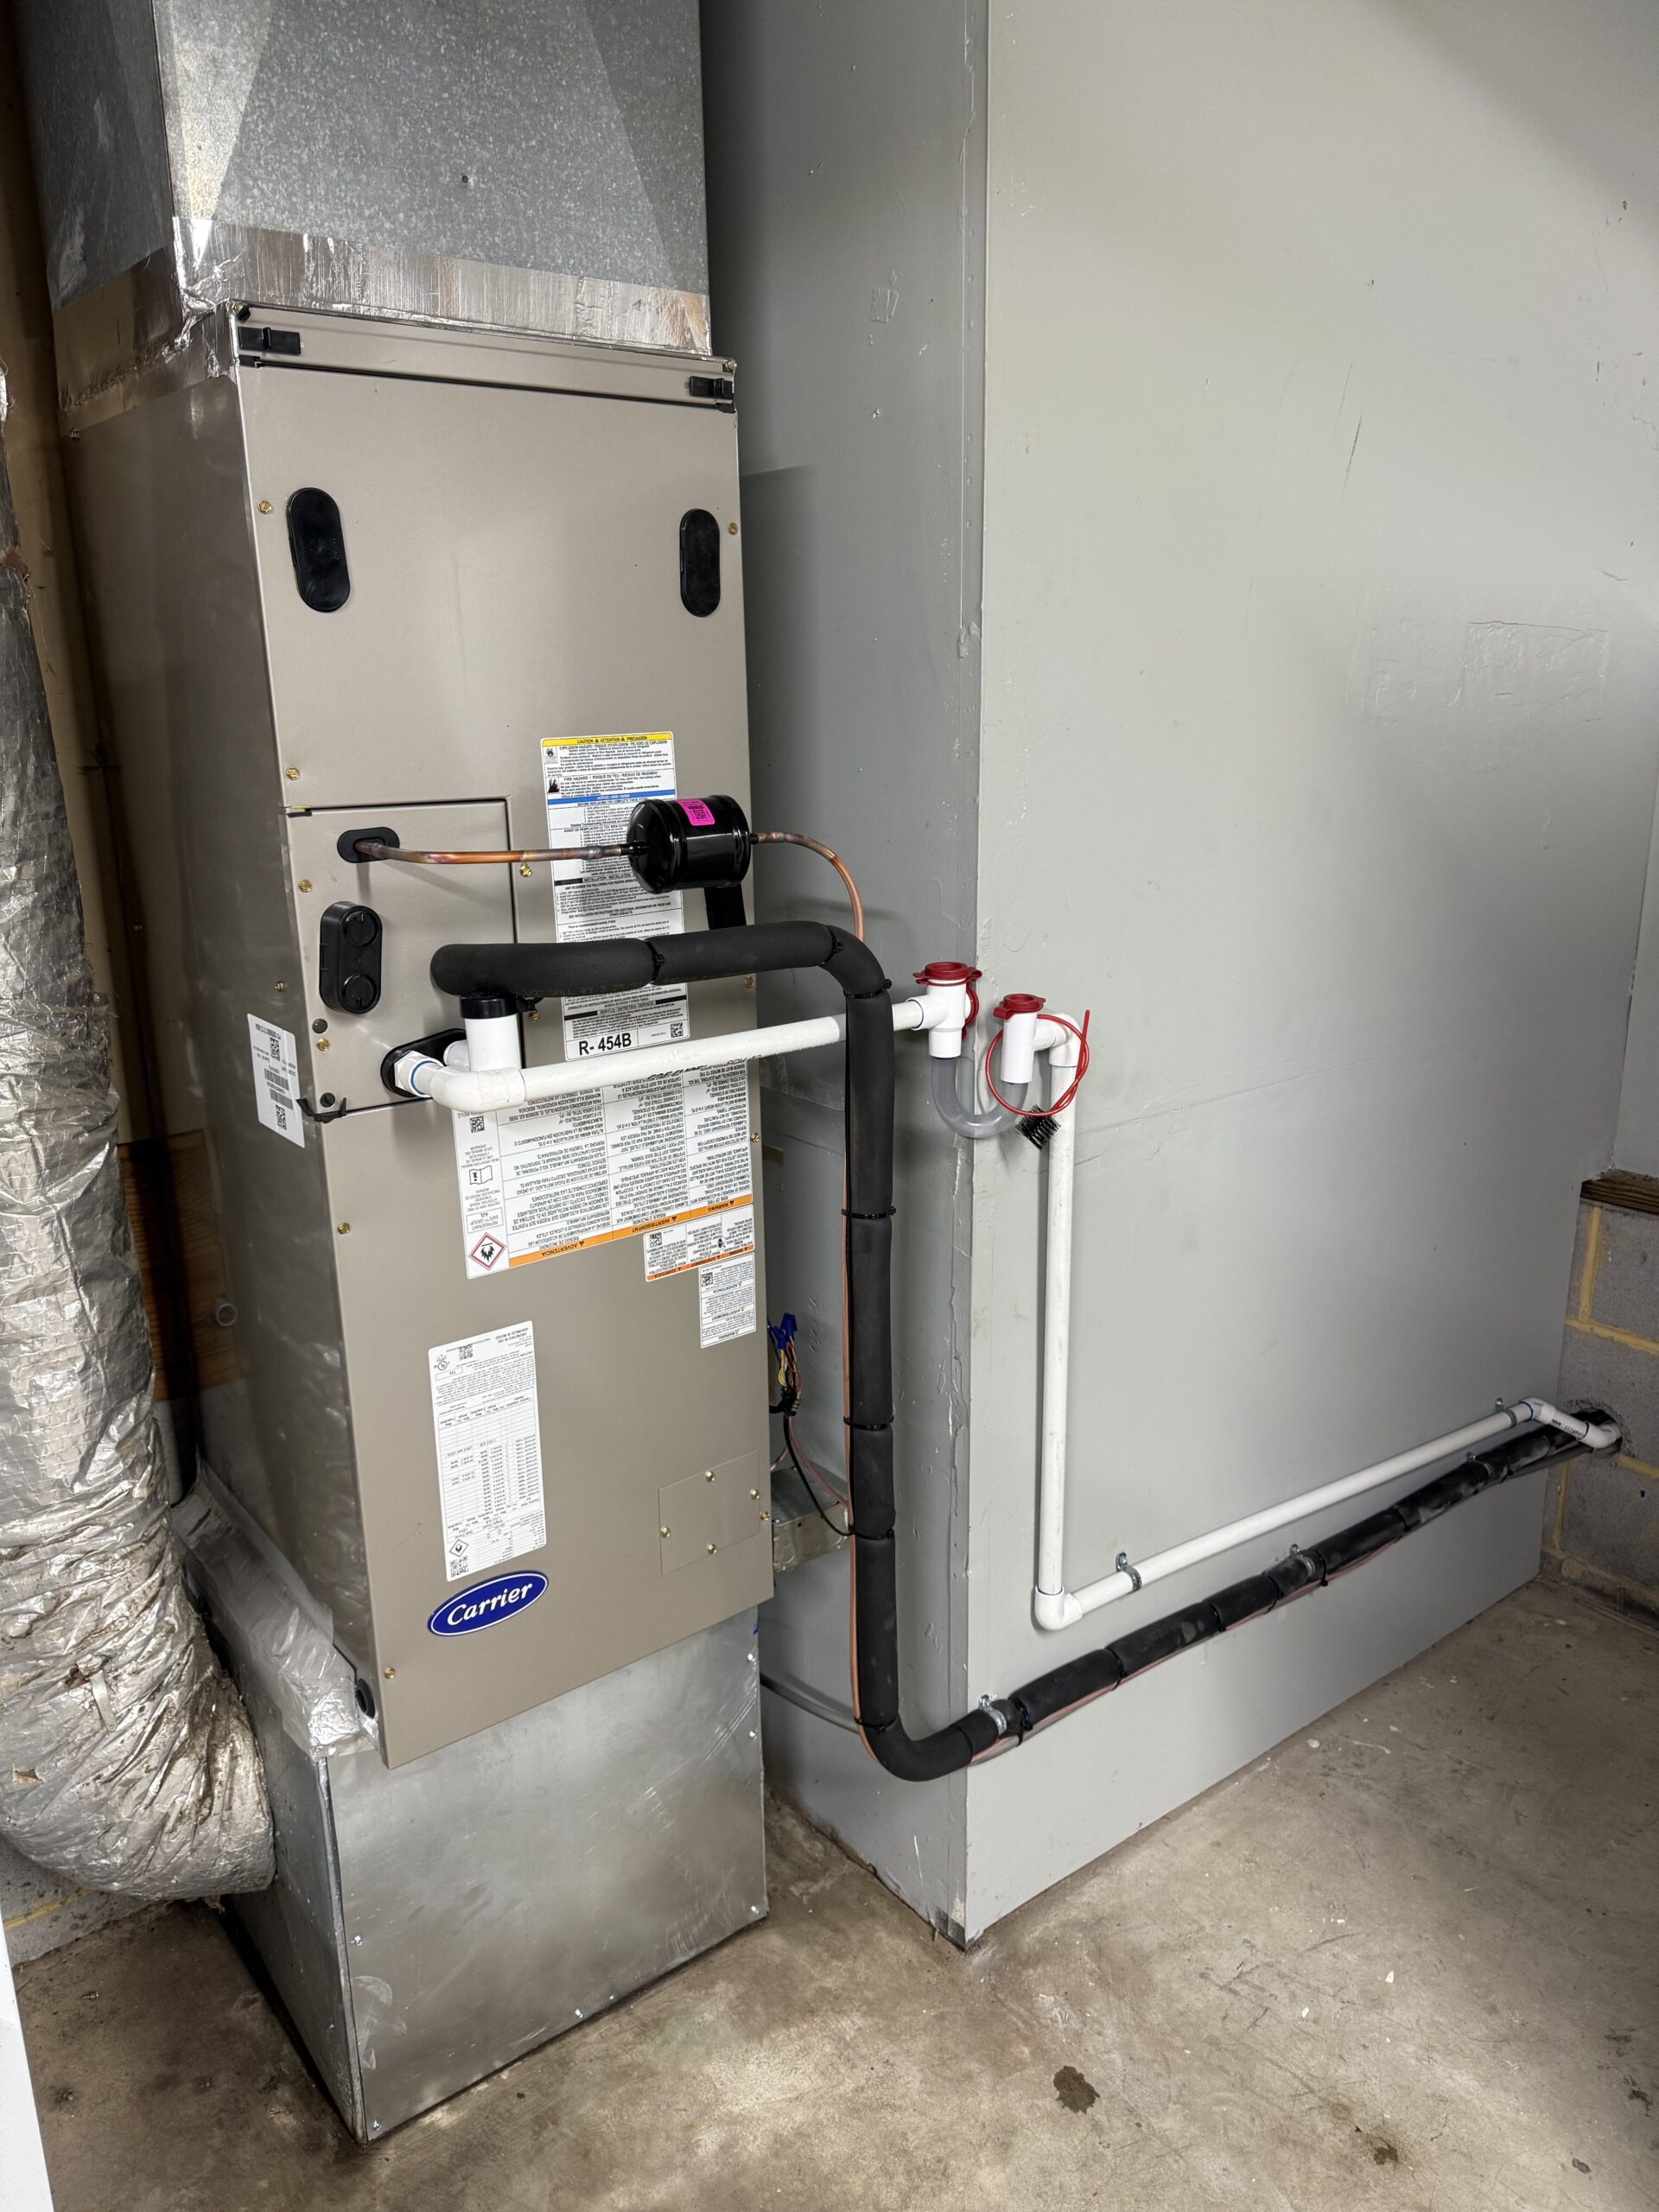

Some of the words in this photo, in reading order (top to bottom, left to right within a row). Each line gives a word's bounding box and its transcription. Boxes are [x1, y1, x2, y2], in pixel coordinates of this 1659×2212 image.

[709, 1203, 728, 1211] WARNING
[632, 1218, 670, 1233] AVERTISSEMENT
[542, 1243, 577, 1257] ADVERTENCIA
[447, 1583, 533, 1626] Carrier
